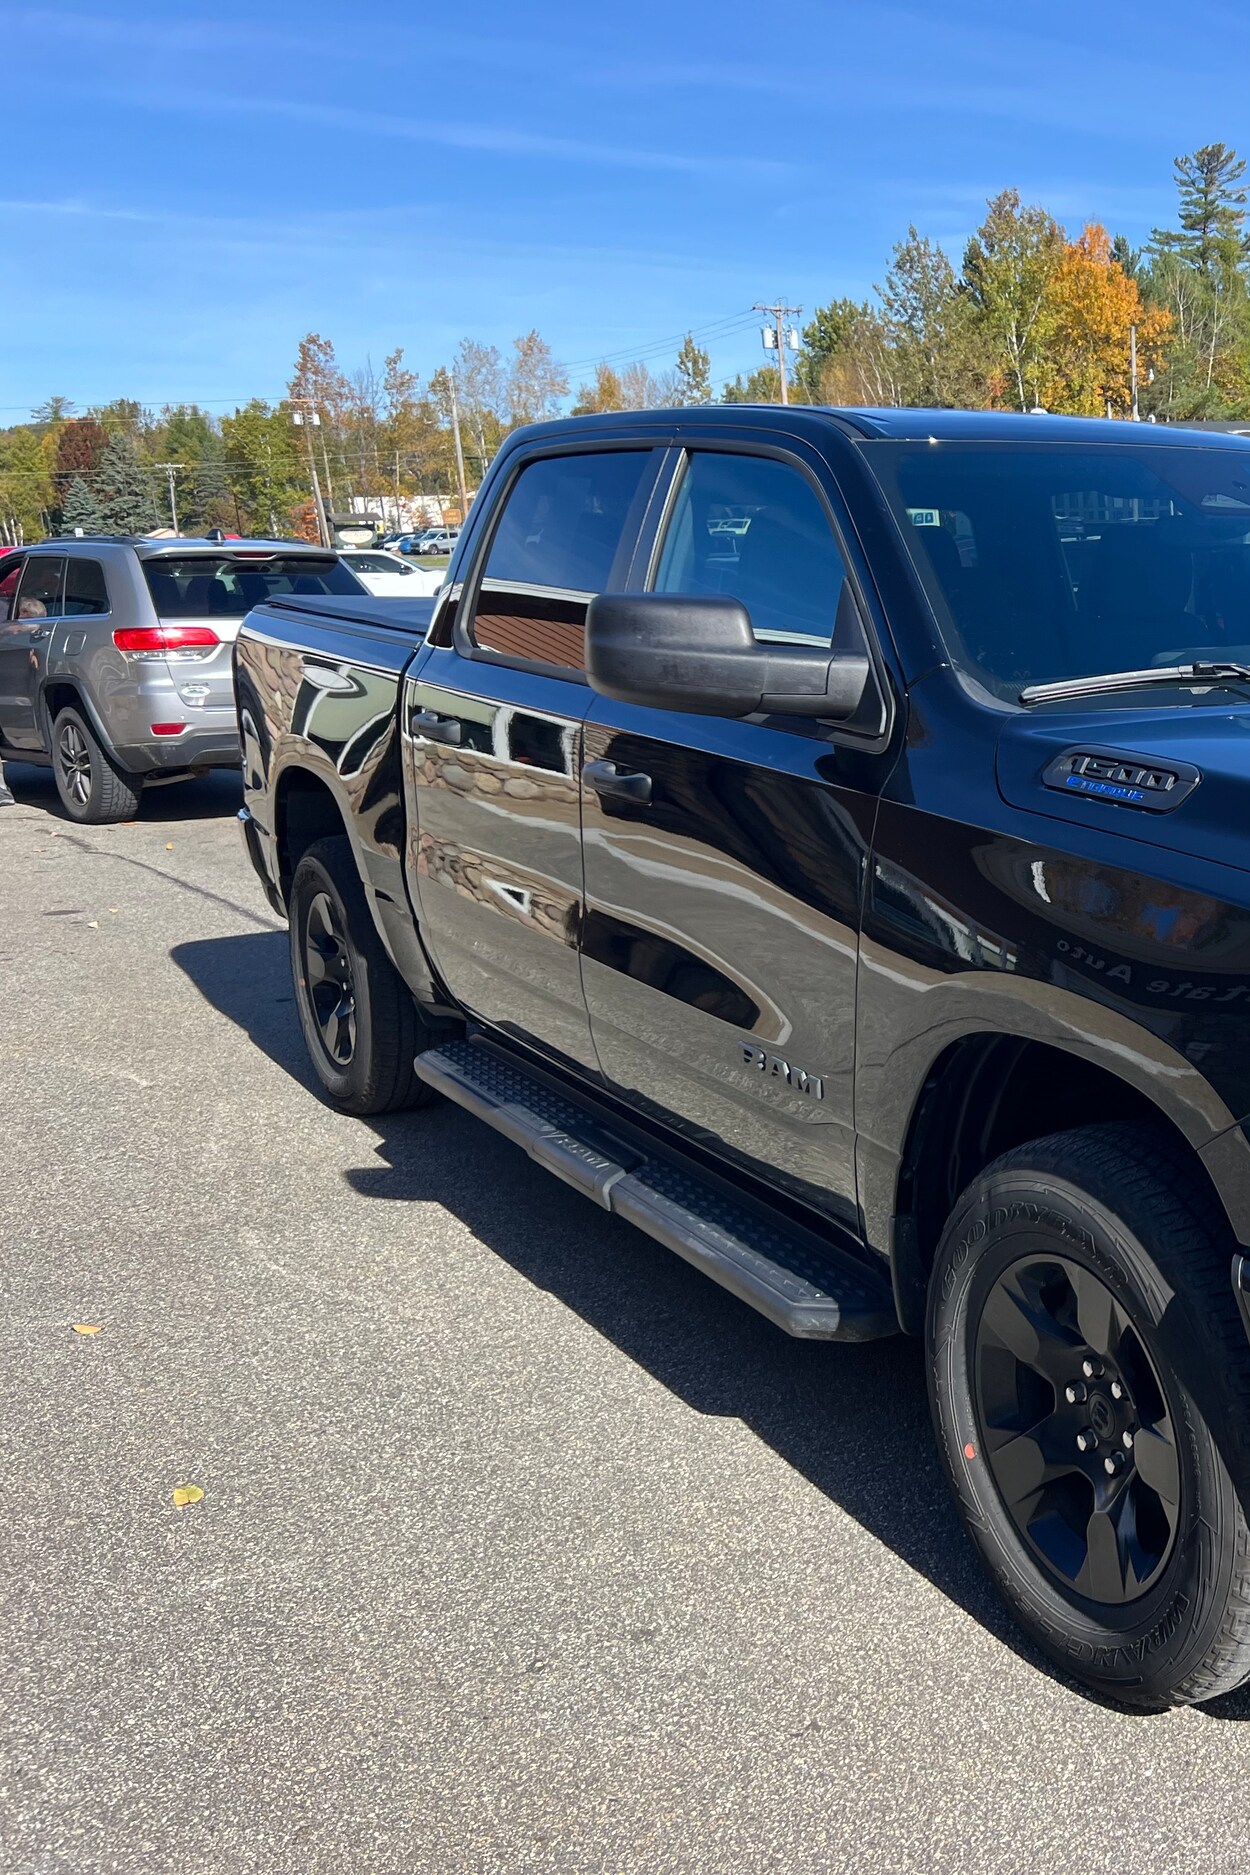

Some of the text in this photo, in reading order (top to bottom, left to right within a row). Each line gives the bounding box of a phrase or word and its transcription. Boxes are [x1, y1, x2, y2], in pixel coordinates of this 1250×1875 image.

[1071, 756, 1175, 791] 1500
[737, 1040, 824, 1101] RAM
[941, 1201, 1129, 1301] GOODYEAR
[995, 1566, 1190, 1667] WRANGLER
